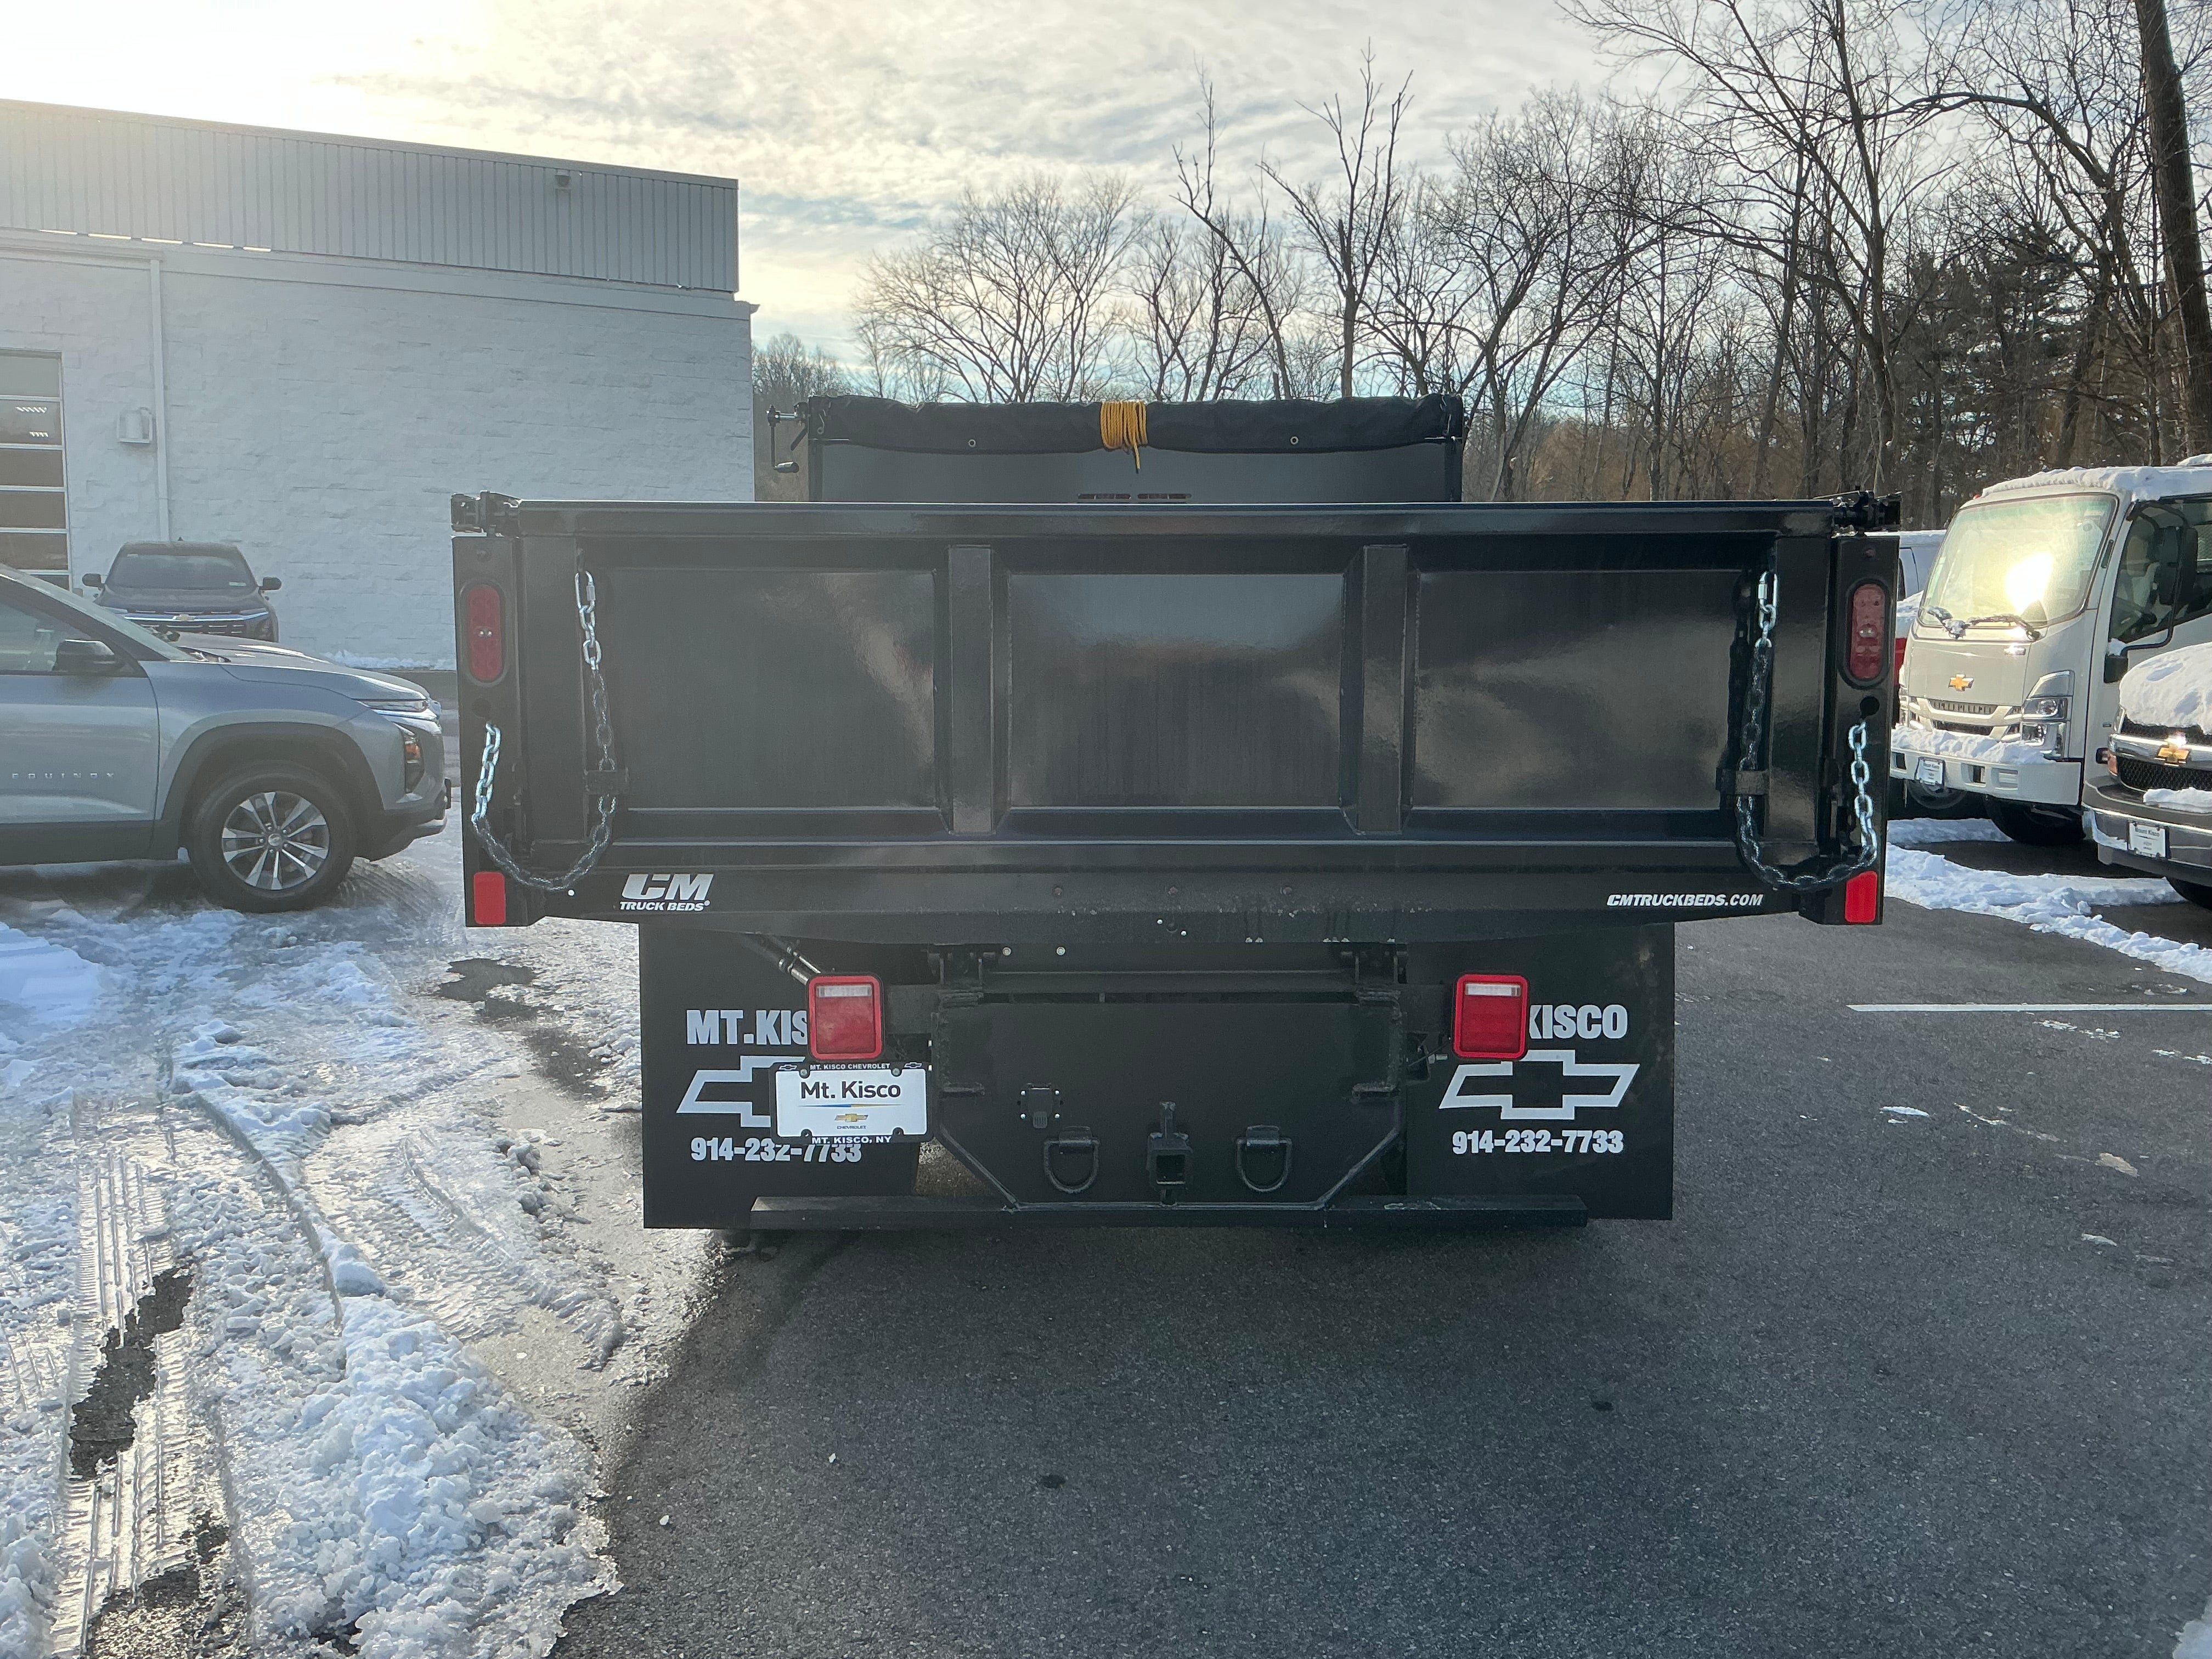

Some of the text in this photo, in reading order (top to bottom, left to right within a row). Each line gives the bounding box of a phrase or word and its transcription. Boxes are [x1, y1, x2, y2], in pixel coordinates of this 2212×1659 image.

[622, 873, 714, 900] CM
[619, 901, 665, 911] TRUCK
[1606, 894, 1764, 906] CMTRUCKBEDS.COM
[686, 1009, 808, 1045] MT.KIS
[800, 1081, 901, 1099] Mt. Kisco
[1452, 1129, 1624, 1155] 914-232-7733
